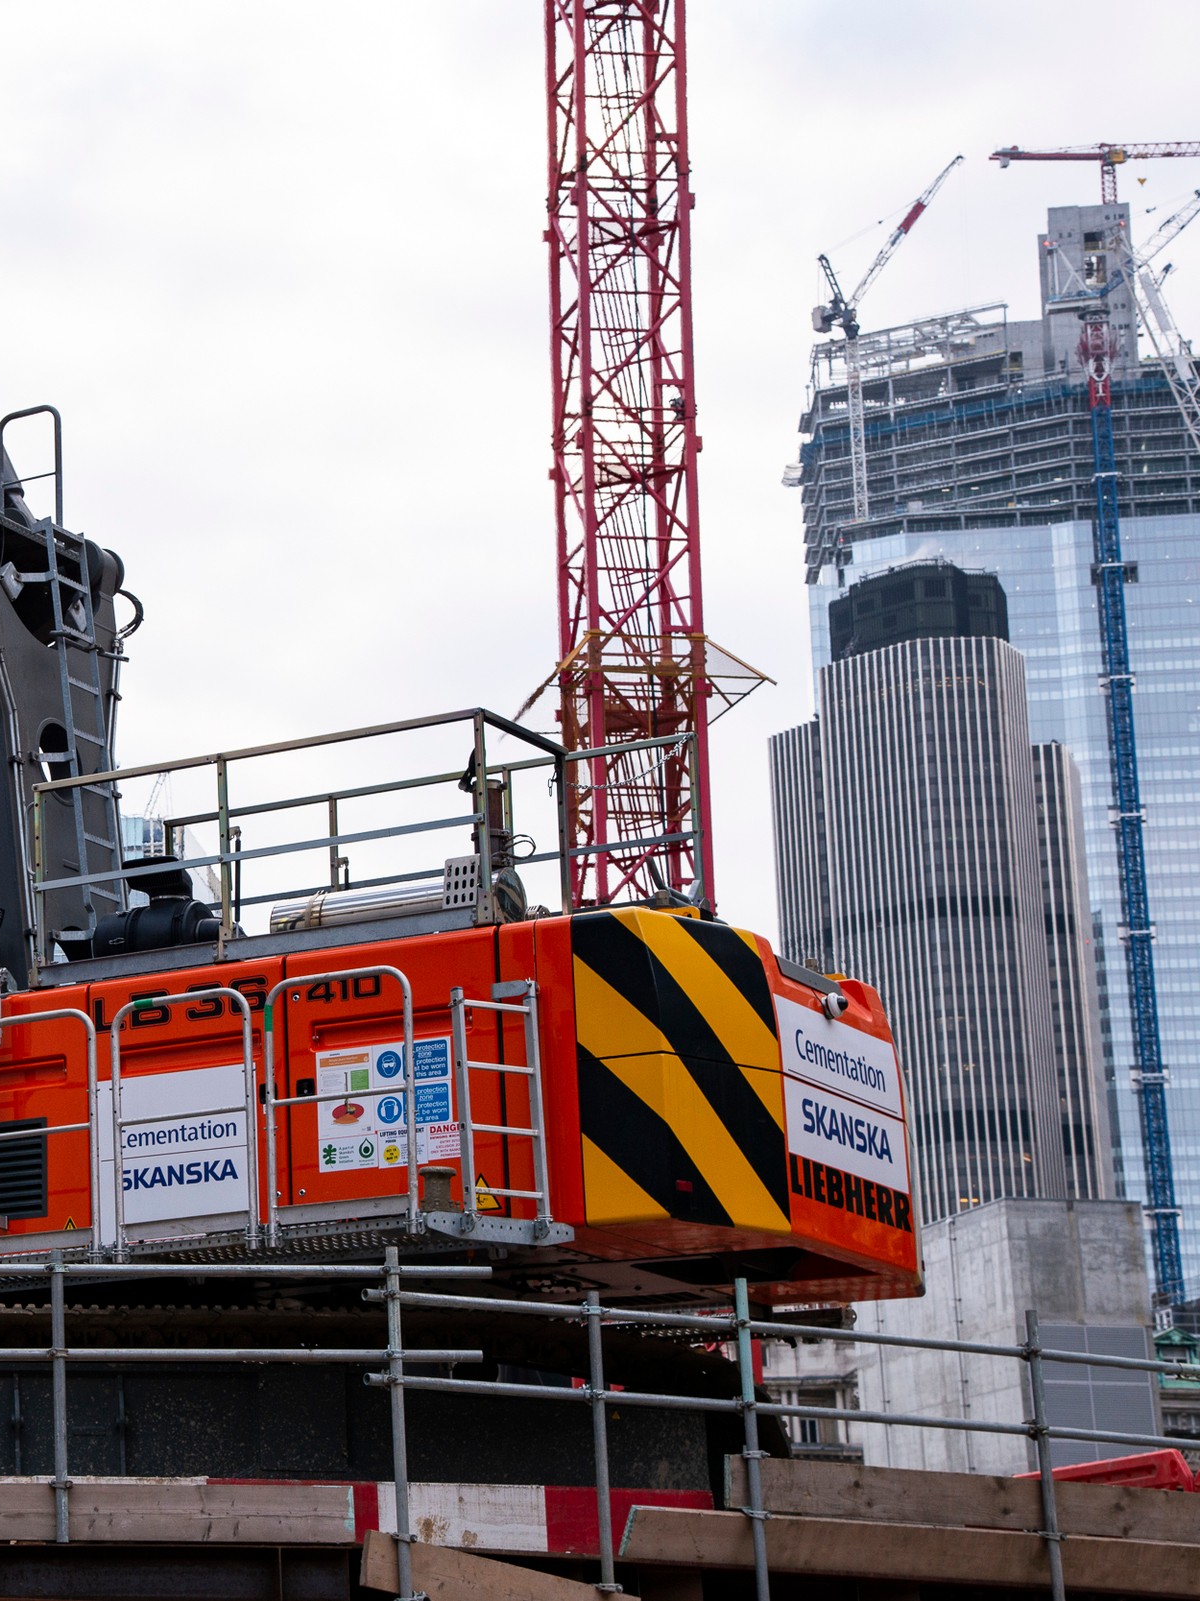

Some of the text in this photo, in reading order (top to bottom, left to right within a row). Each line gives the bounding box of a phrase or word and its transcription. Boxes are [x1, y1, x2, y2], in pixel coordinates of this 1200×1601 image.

[93, 988, 172, 1033] LB
[186, 975, 269, 1021] 36
[416, 1043, 445, 1051] protection
[416, 1056, 446, 1065] protection
[795, 1029, 886, 1092] Cementation
[417, 1086, 447, 1095] protection
[417, 1101, 447, 1109] protection
[430, 1123, 460, 1134] DANG
[801, 1098, 893, 1164] SKANSKA
[122, 1159, 238, 1191] SKANSKA
[789, 1153, 912, 1233] LIEBHERR
